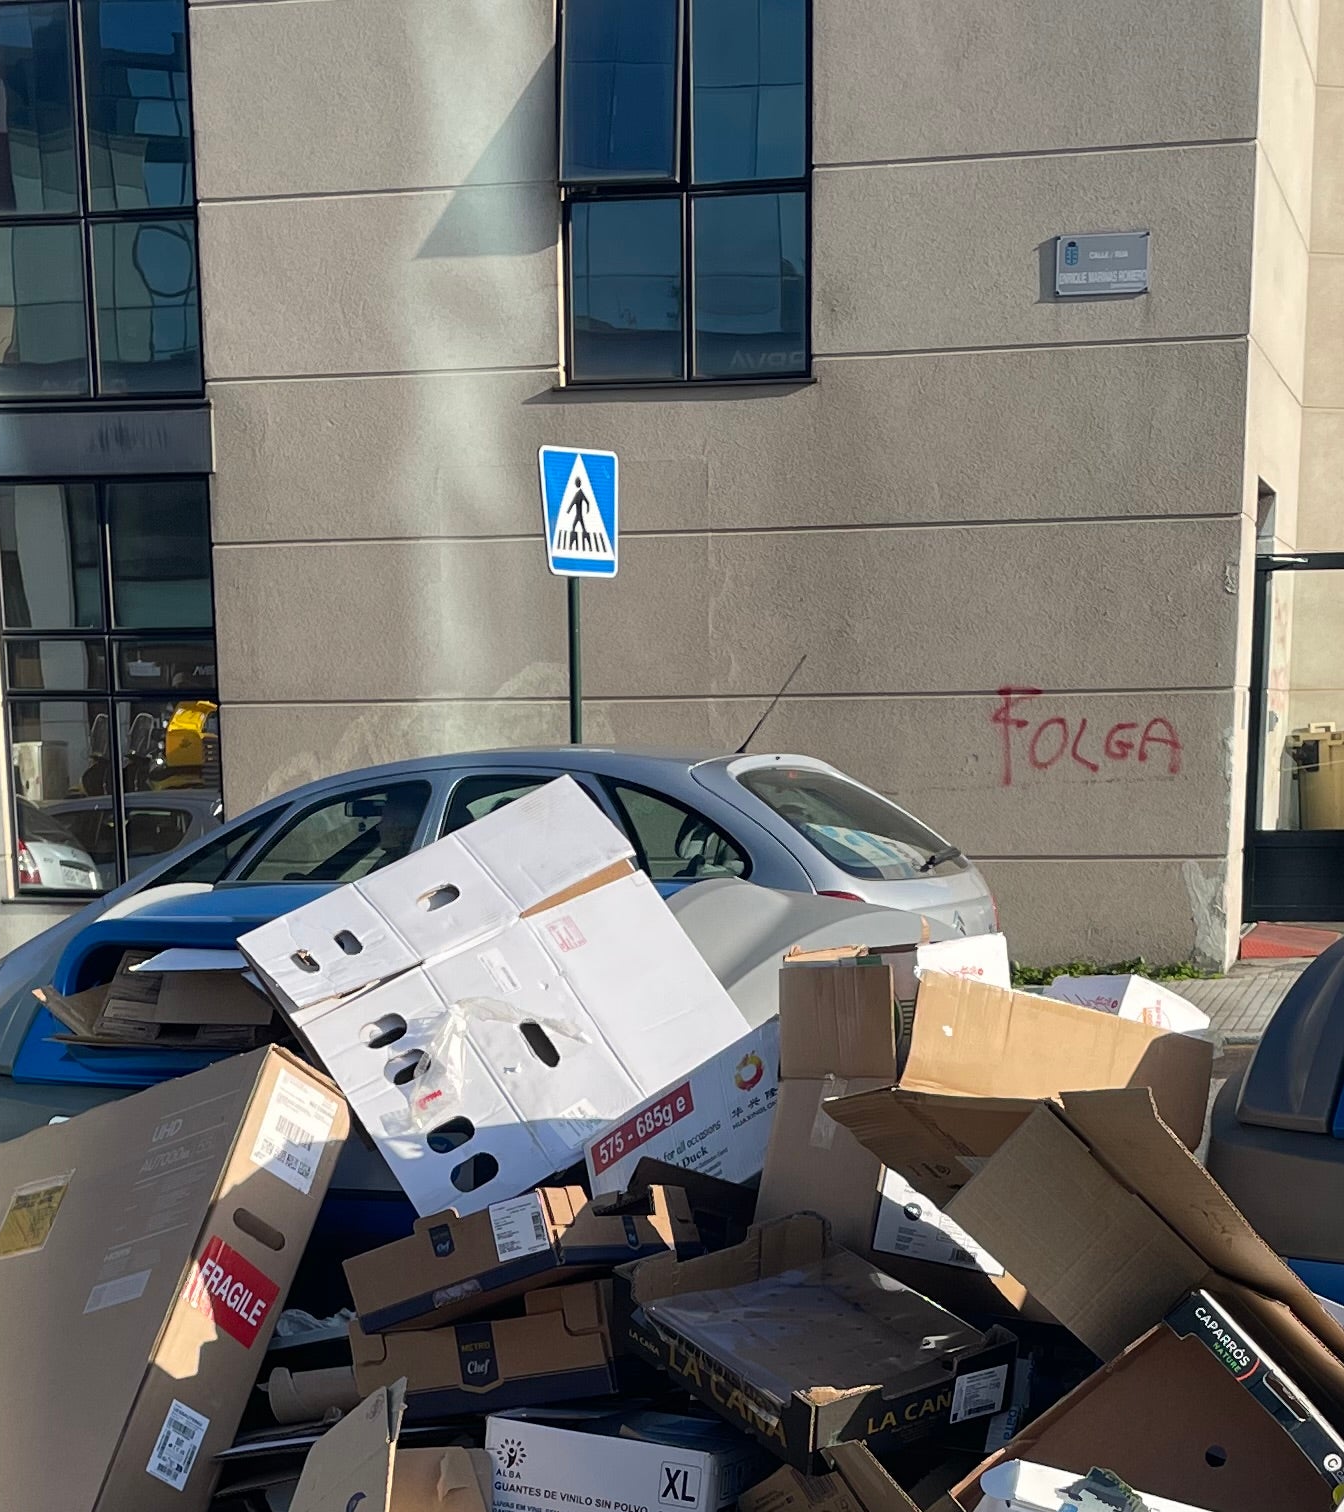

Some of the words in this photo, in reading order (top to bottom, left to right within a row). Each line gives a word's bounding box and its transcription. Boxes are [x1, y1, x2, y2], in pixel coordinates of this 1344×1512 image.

[990, 684, 1184, 787] FOLGA
[151, 1118, 184, 1143] UHD
[599, 1132, 624, 1164] 575
[636, 1102, 672, 1138] 685g
[676, 1096, 686, 1113] e
[663, 1148, 675, 1161] for
[687, 1121, 721, 1147] occasions
[682, 1146, 709, 1169] Duck
[201, 1257, 267, 1327] FRAGILE
[1195, 1307, 1250, 1367] CAPARRÓS
[467, 1358, 490, 1374] Chef
[666, 1340, 702, 1387] LA
[1213, 1342, 1242, 1374] NATURE
[867, 1412, 896, 1434] LA
[904, 1387, 952, 1422] CAÑ
[496, 1468, 522, 1480] ALBA
[661, 1467, 696, 1502] XL
[494, 1481, 541, 1497] GUANTES
[544, 1490, 557, 1500] DE
[560, 1491, 592, 1506] VINILO
[594, 1499, 611, 1509] SIN
